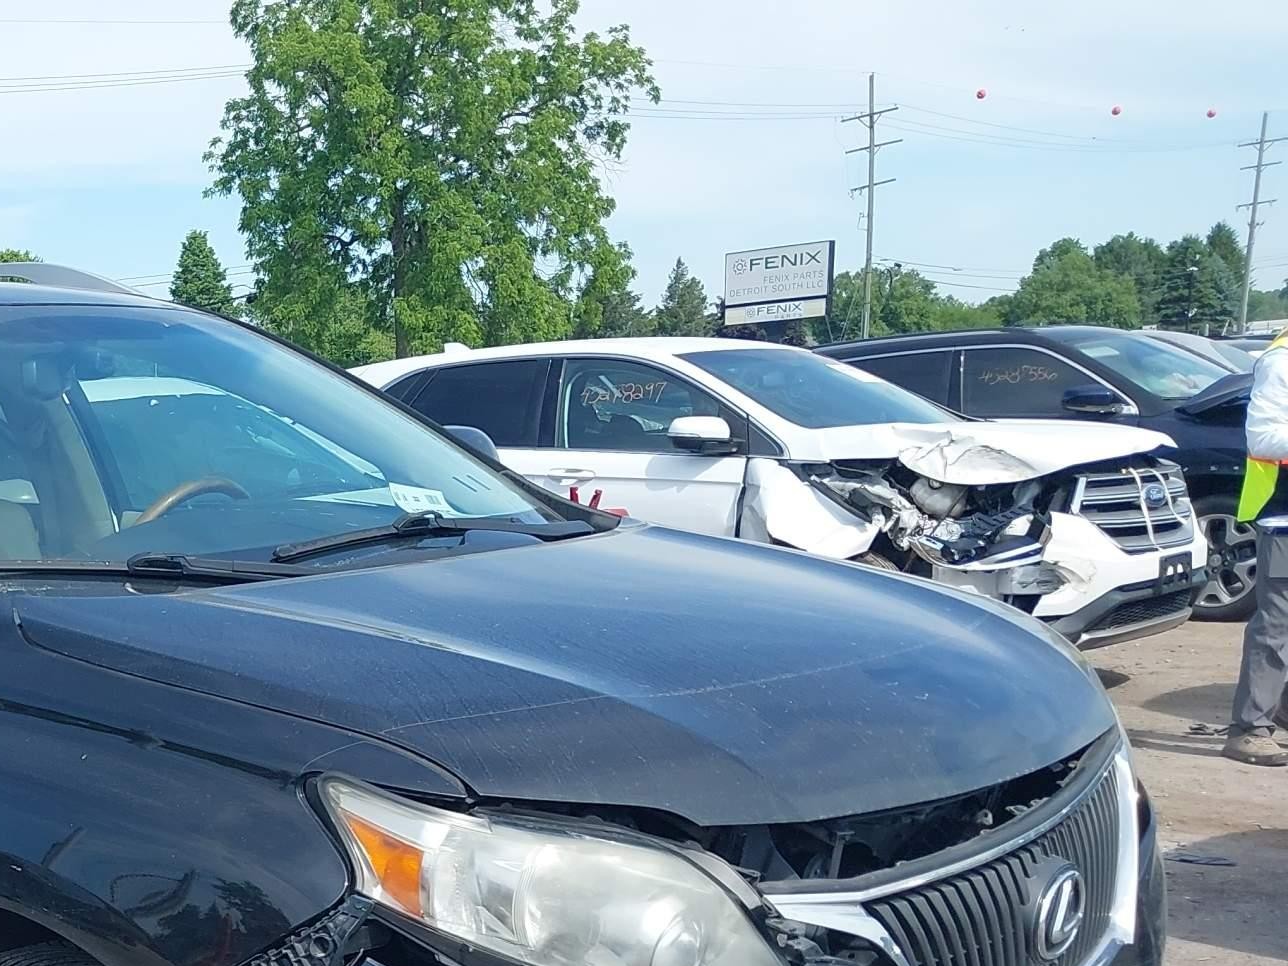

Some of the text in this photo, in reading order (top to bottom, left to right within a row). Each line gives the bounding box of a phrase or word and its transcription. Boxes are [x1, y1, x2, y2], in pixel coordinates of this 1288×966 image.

[750, 250, 821, 272] FENIX
[763, 271, 824, 284] FENIX PARTS
[730, 280, 824, 297] DETROIT SOUTH LLC
[757, 302, 802, 316] FENIX
